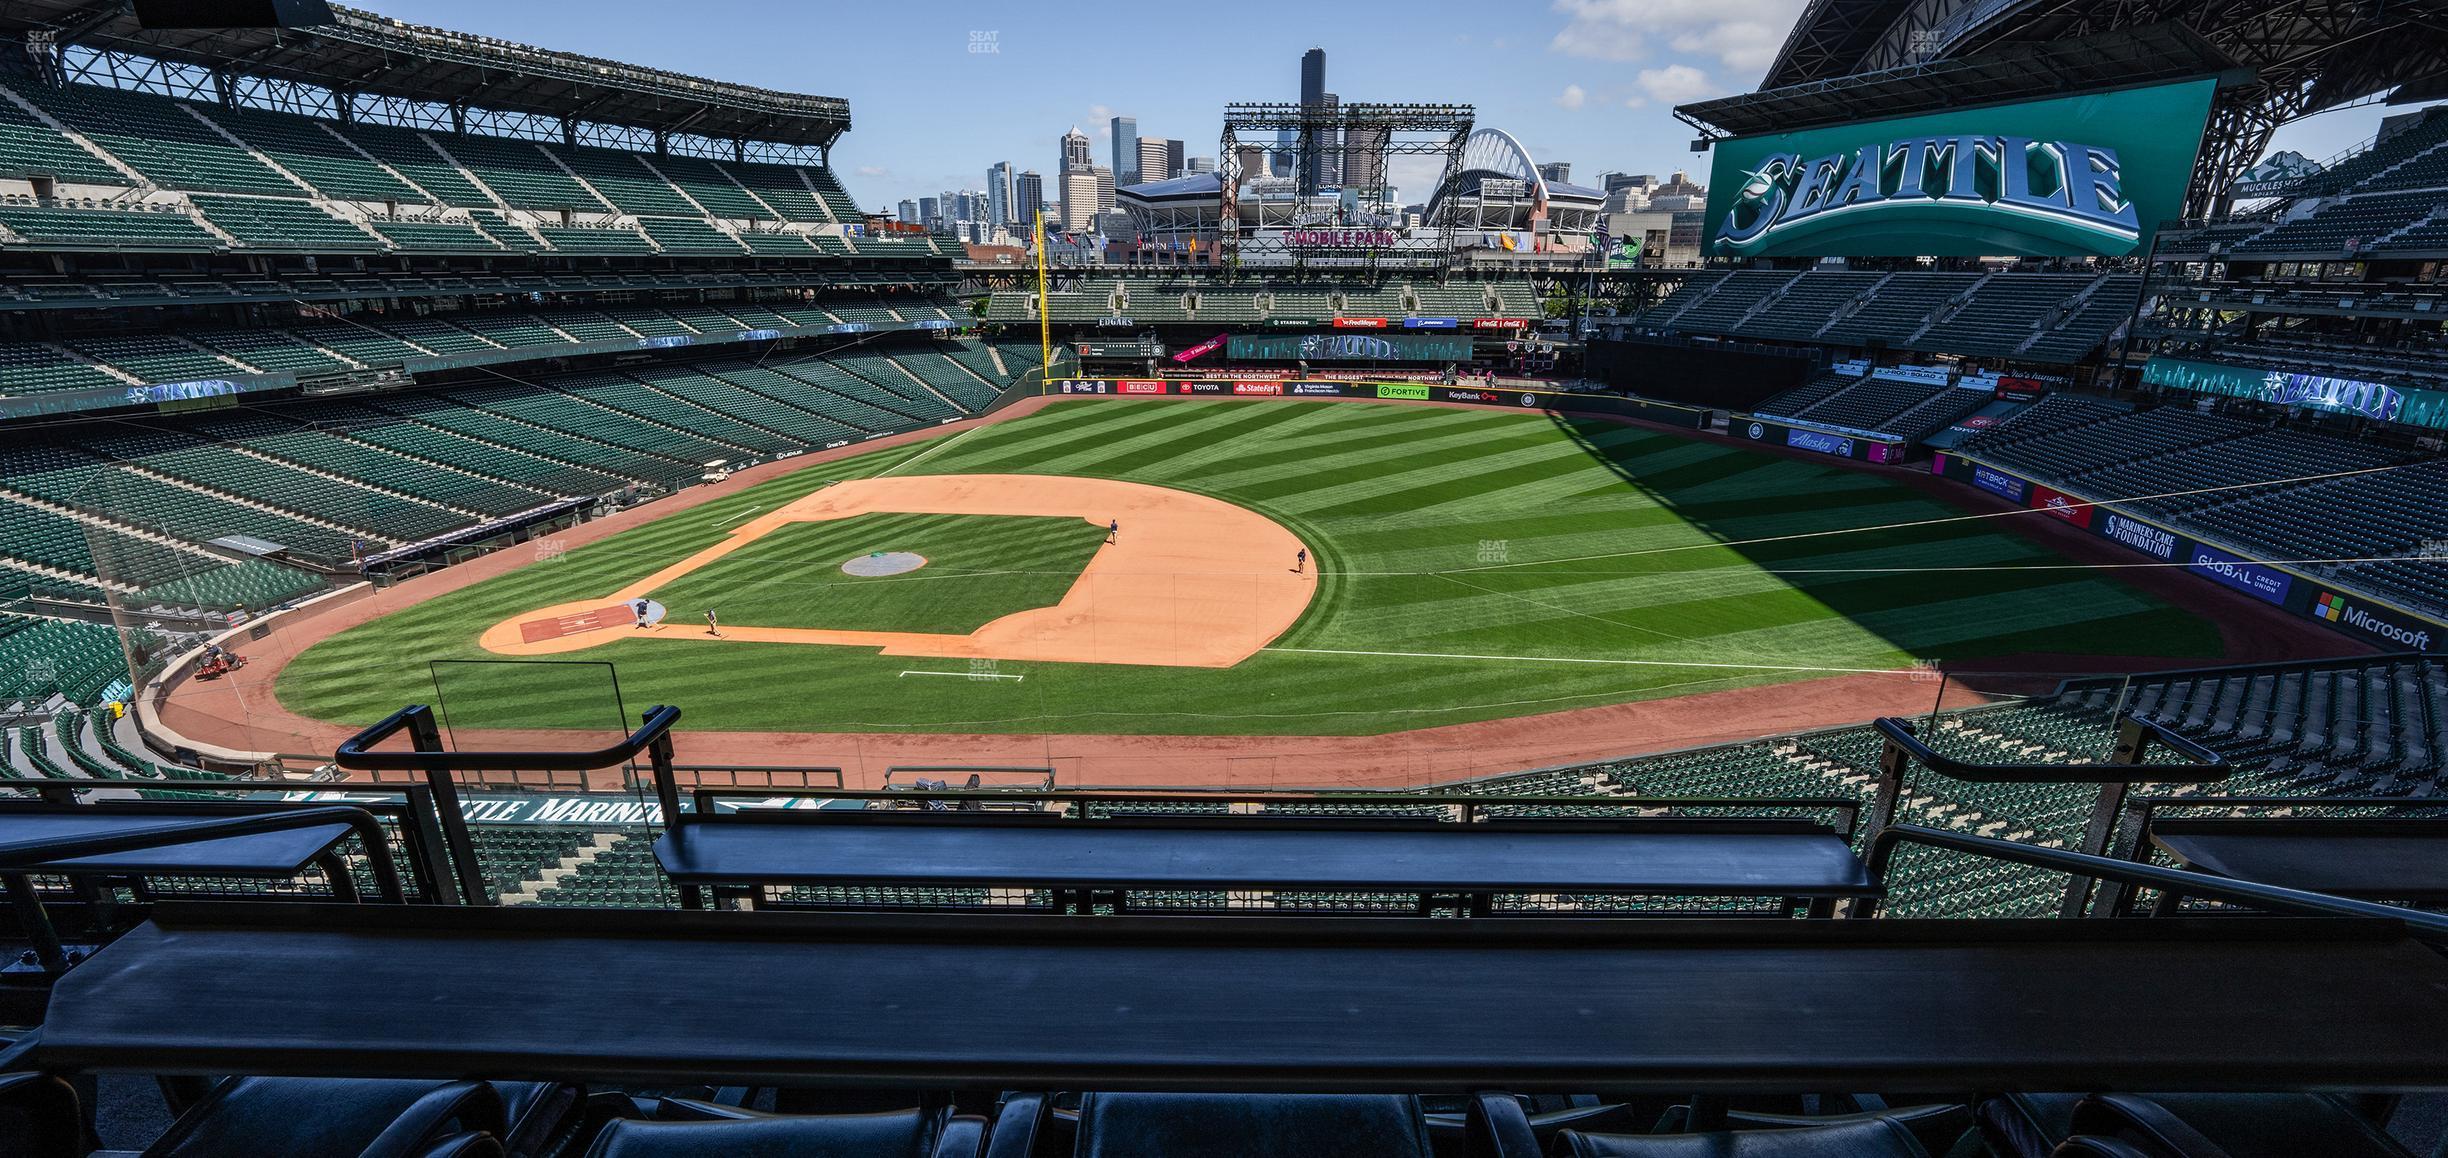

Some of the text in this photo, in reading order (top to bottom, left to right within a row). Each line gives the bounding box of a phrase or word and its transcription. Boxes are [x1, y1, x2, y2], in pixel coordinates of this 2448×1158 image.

[1714, 135, 2140, 247] SEATTLE
[1283, 230, 1395, 246] T-MOBILE PARK
[1128, 383, 1156, 391] BECU
[1391, 388, 1426, 396] FORTIVE
[1449, 391, 1480, 400] KeyBank
[1791, 433, 1831, 450] Alaska
[1976, 468, 2009, 487] HATBACK
[2119, 517, 2155, 539] MARINERS
[2154, 530, 2176, 547] CARE
[2115, 527, 2173, 559] FOUNDATION
[2198, 554, 2281, 588] GLOBAL CREDIT
[2254, 581, 2276, 594] UNION
[2343, 606, 2430, 651] Microsoft
